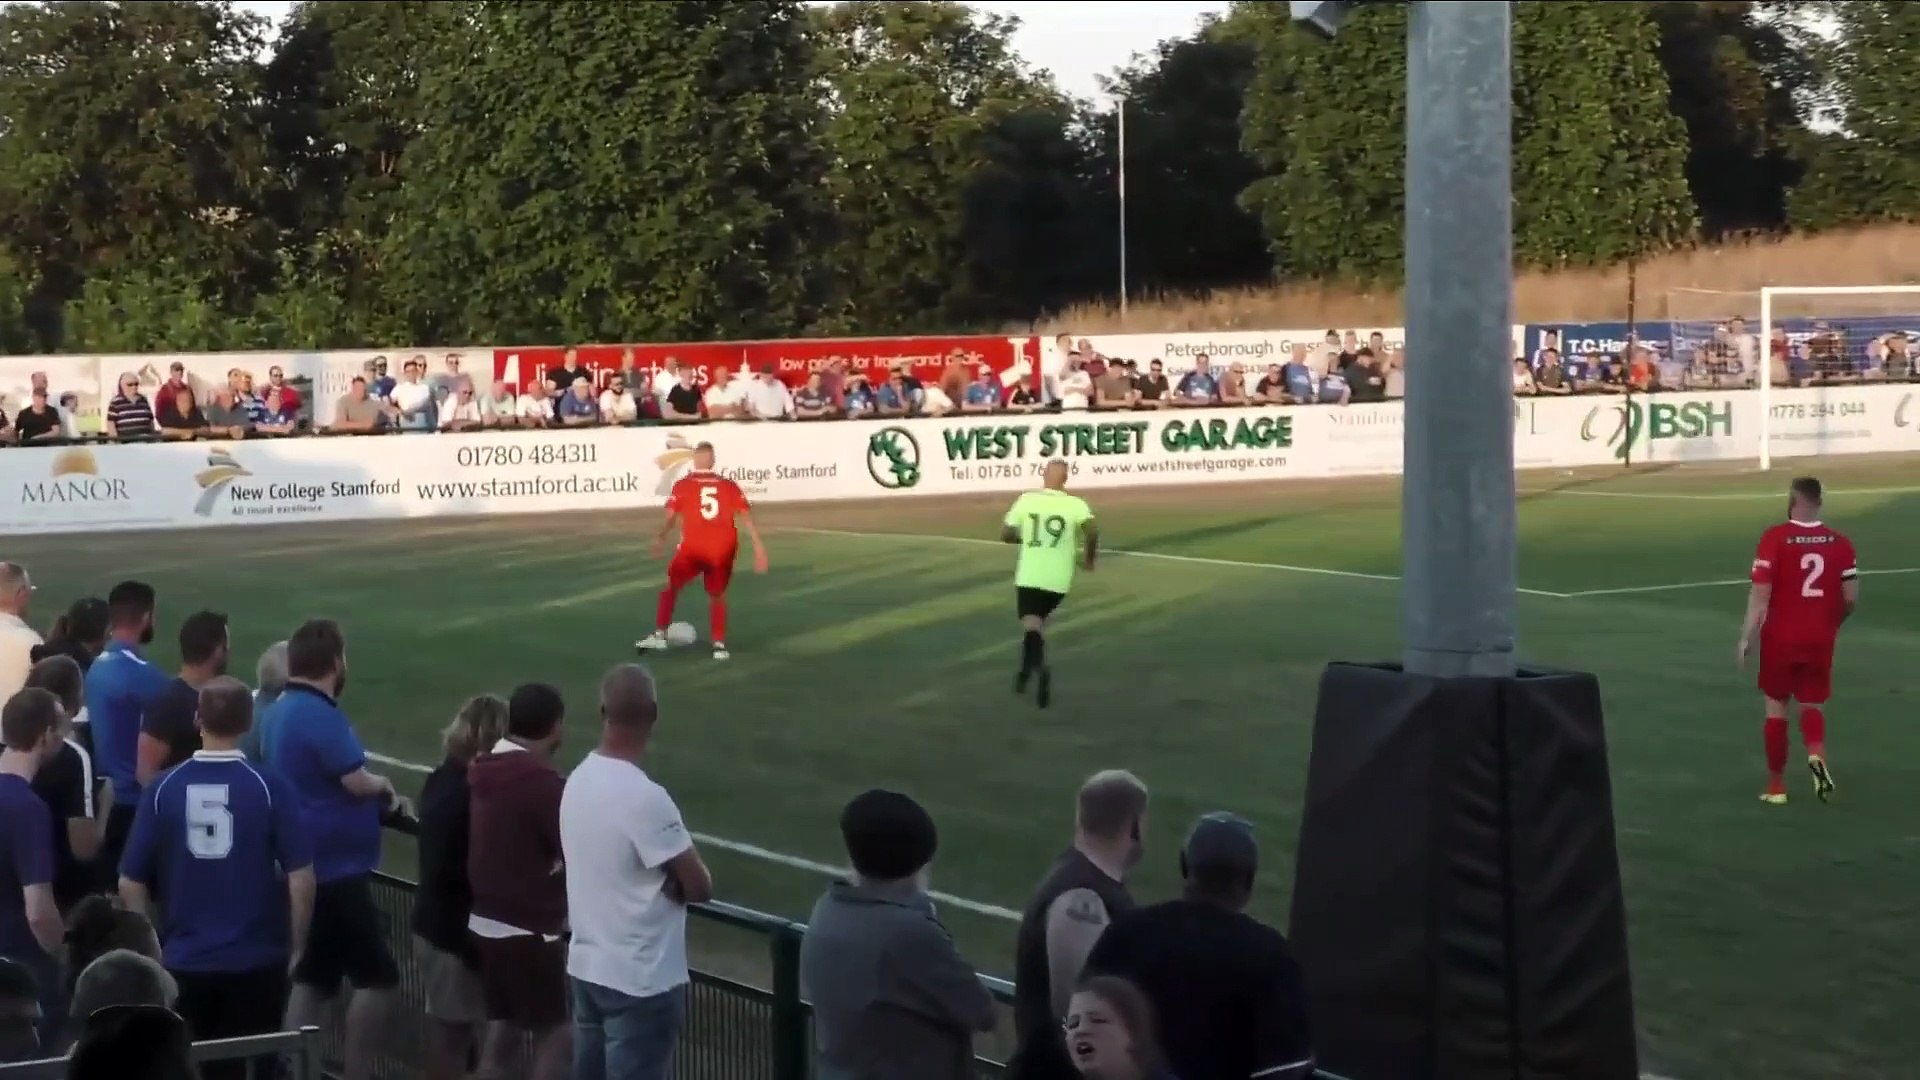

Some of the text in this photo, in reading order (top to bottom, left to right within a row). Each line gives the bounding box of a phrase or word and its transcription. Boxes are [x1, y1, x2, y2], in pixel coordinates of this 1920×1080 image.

[1165, 339, 1274, 358] Peterborough
[780, 356, 804, 371] low
[852, 354, 870, 368] for
[1649, 401, 1732, 439] BSH
[942, 415, 1294, 461] WEST STREET GARAGE
[457, 443, 598, 466] 01780 484311
[978, 464, 1022, 478] 01780
[1091, 455, 1287, 476] www.weststreetgarage.com
[775, 462, 837, 480] Stamford
[22, 478, 130, 504] MANOR
[231, 478, 400, 503] New College Stamford
[417, 472, 638, 499] www.stamford.ac.uk
[700, 486, 720, 520] 5
[1027, 513, 1066, 548] 19
[1800, 553, 1825, 598] 2
[186, 784, 234, 859] 5
